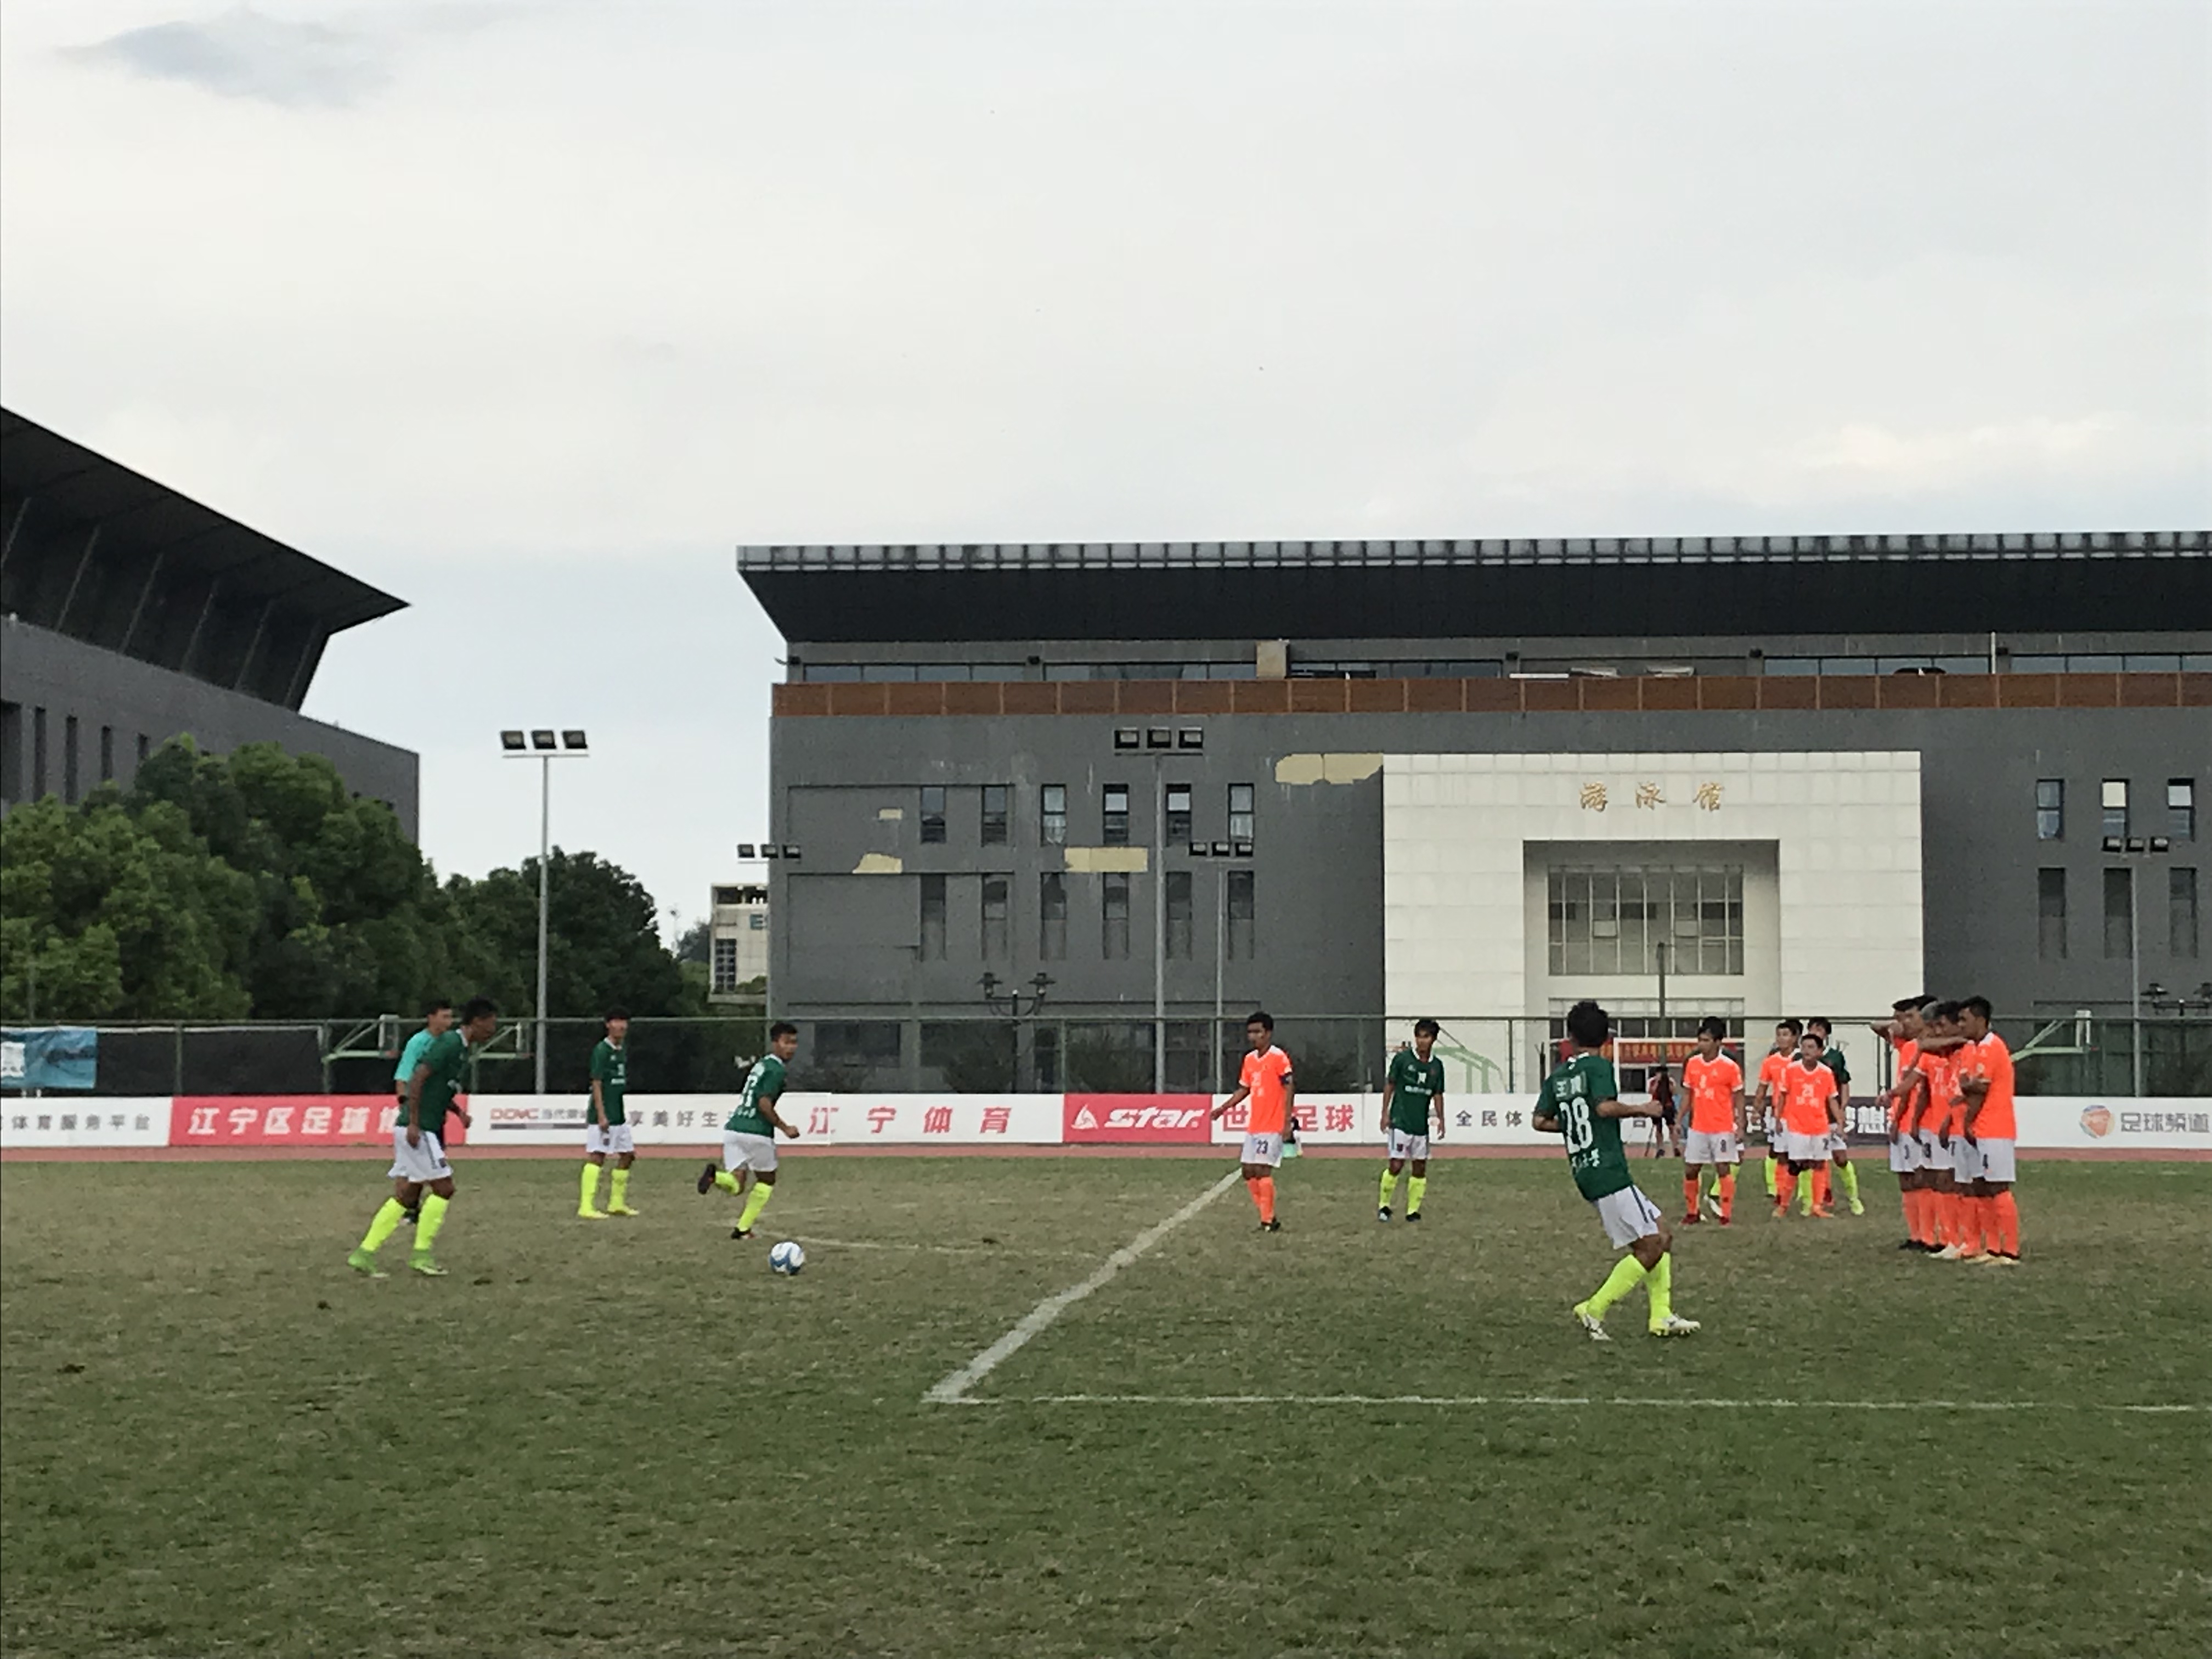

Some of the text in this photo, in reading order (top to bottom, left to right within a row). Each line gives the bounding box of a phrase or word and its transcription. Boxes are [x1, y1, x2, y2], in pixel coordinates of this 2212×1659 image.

[1579, 781, 1725, 812] 游泳馆
[0, 1113, 150, 1131] 体育服务平台
[628, 1110, 734, 1127] 享美好生
[808, 1106, 1012, 1135] 江宁体育
[1559, 1097, 1593, 1154] 28
[2120, 1111, 2210, 1133] 足球频道
[1256, 1139, 1269, 1154] 23
